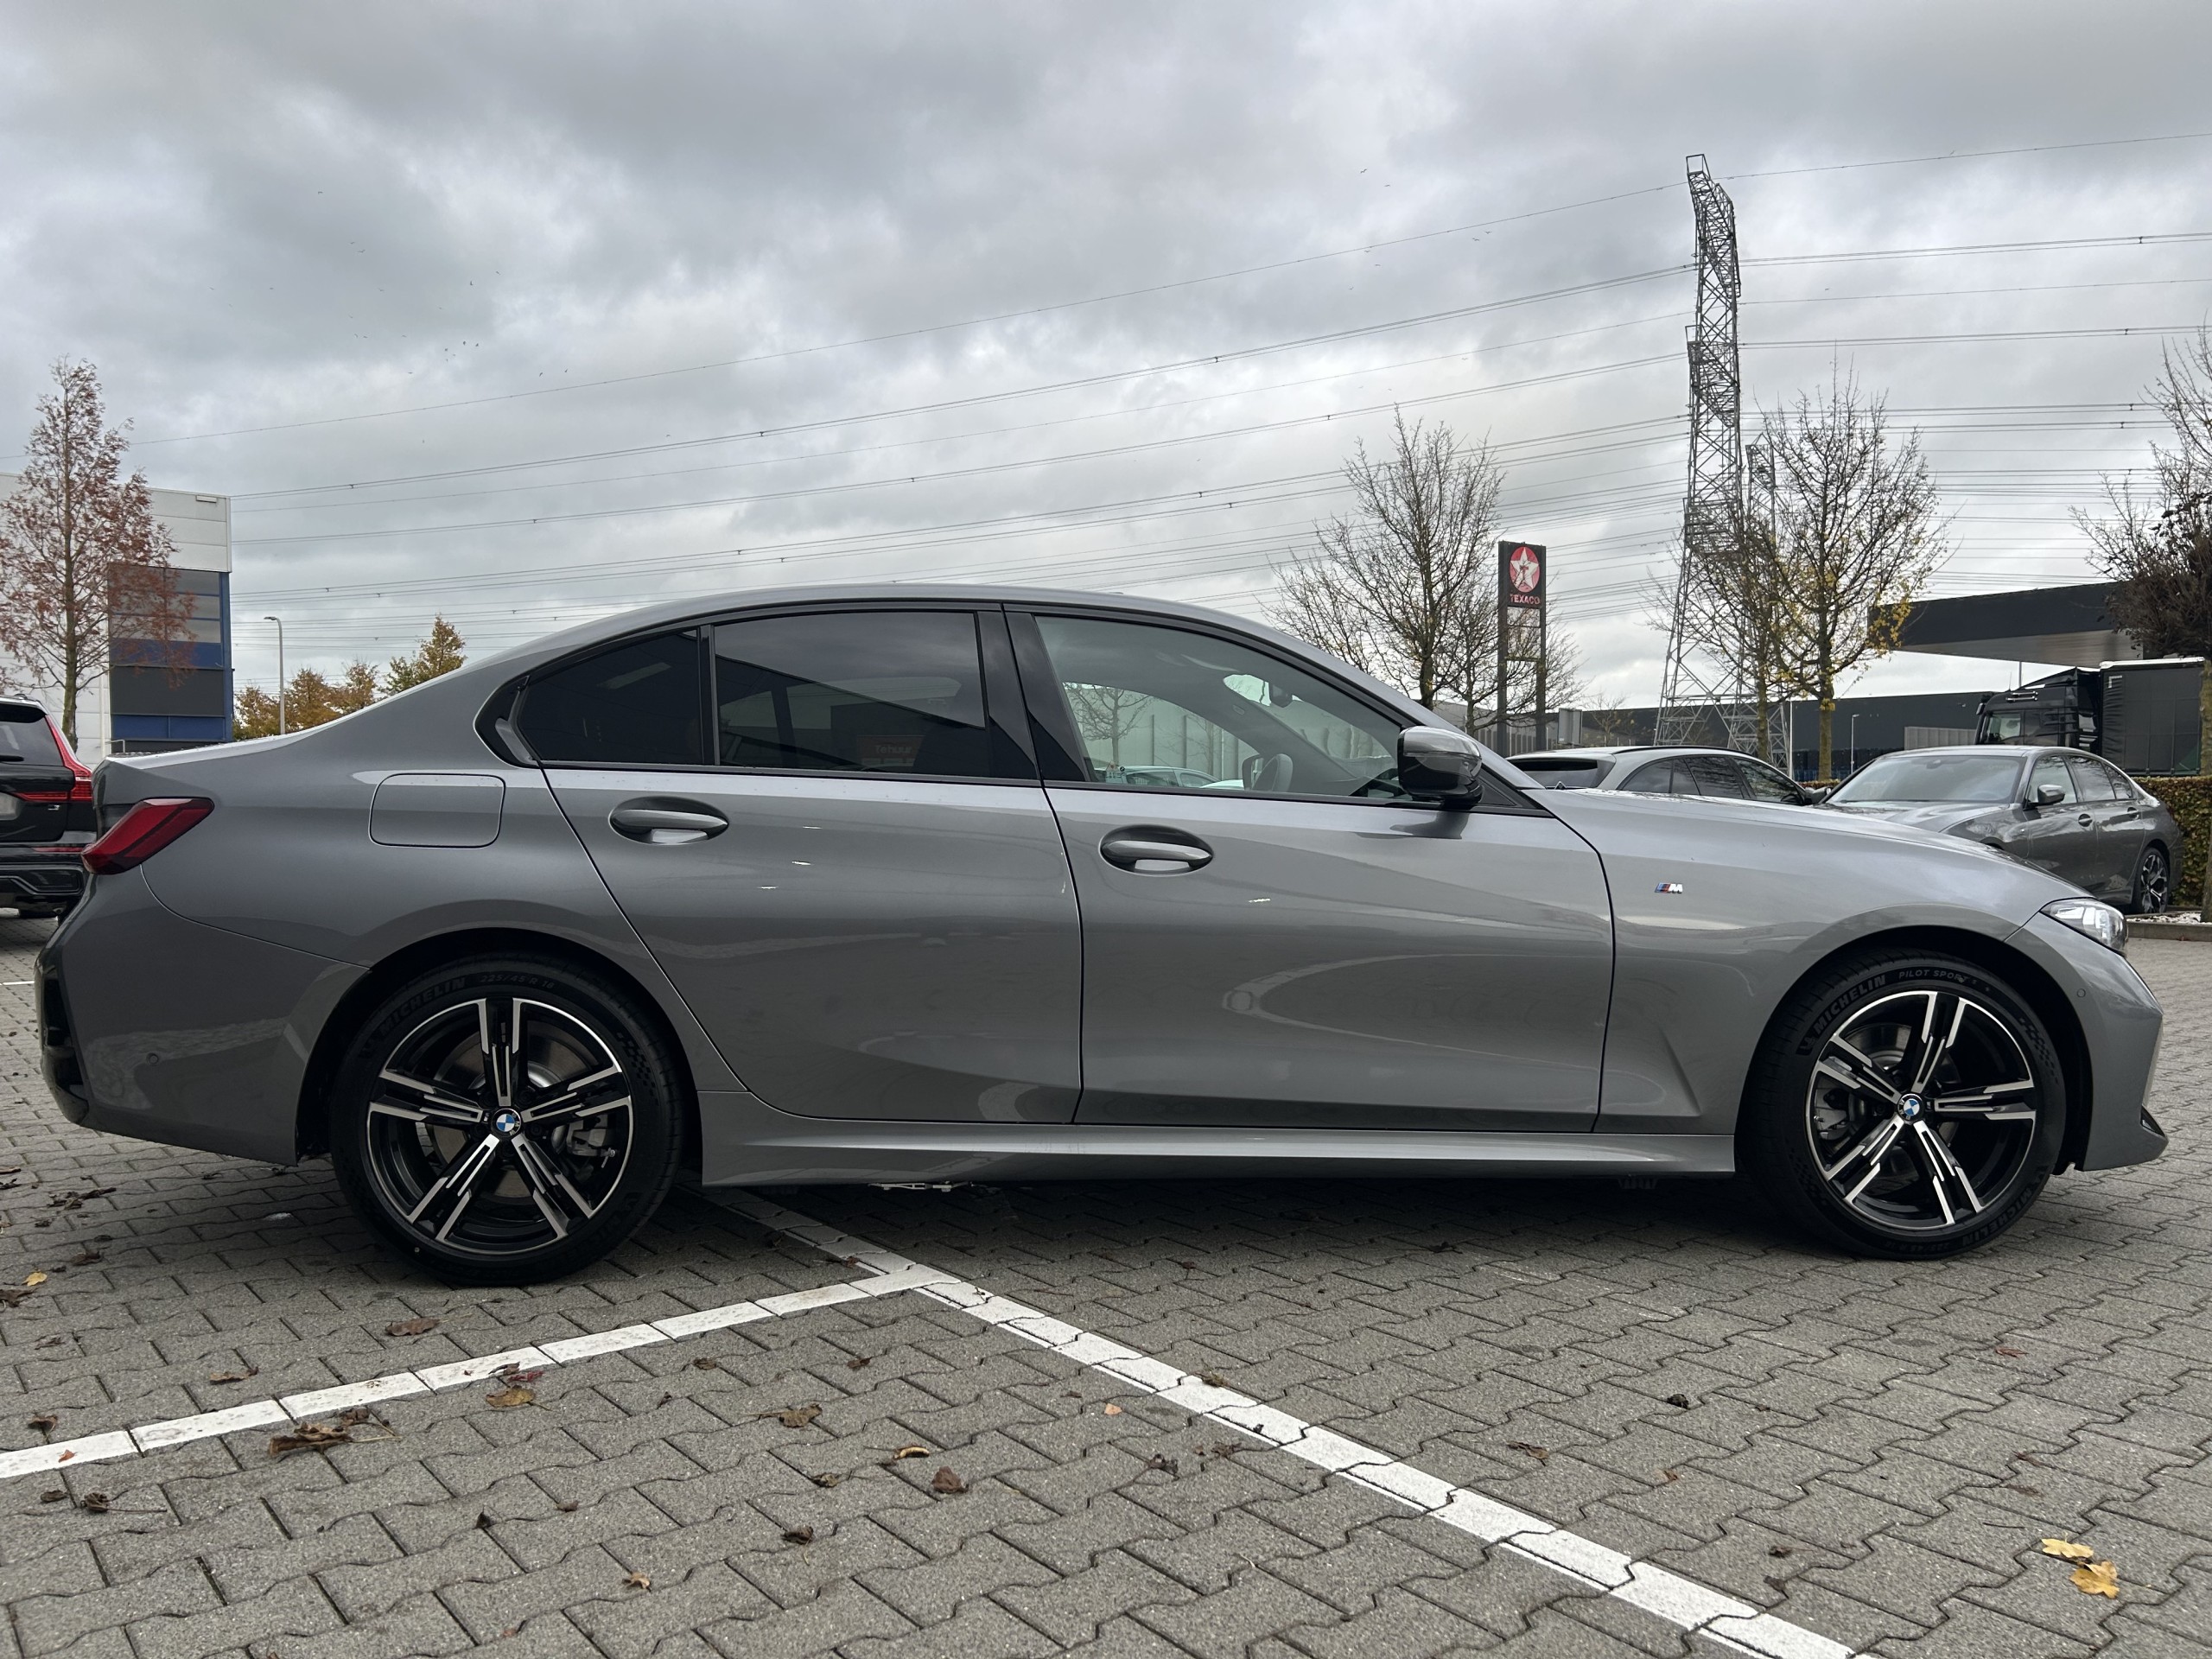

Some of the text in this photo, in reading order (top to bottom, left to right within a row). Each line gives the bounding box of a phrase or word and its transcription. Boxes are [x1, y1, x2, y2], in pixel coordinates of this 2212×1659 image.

[1510, 594, 1541, 605] TEXACO
[378, 977, 466, 1036] MICHELIN
[1812, 969, 1970, 1036] MICHELIN PILOT SPORT
